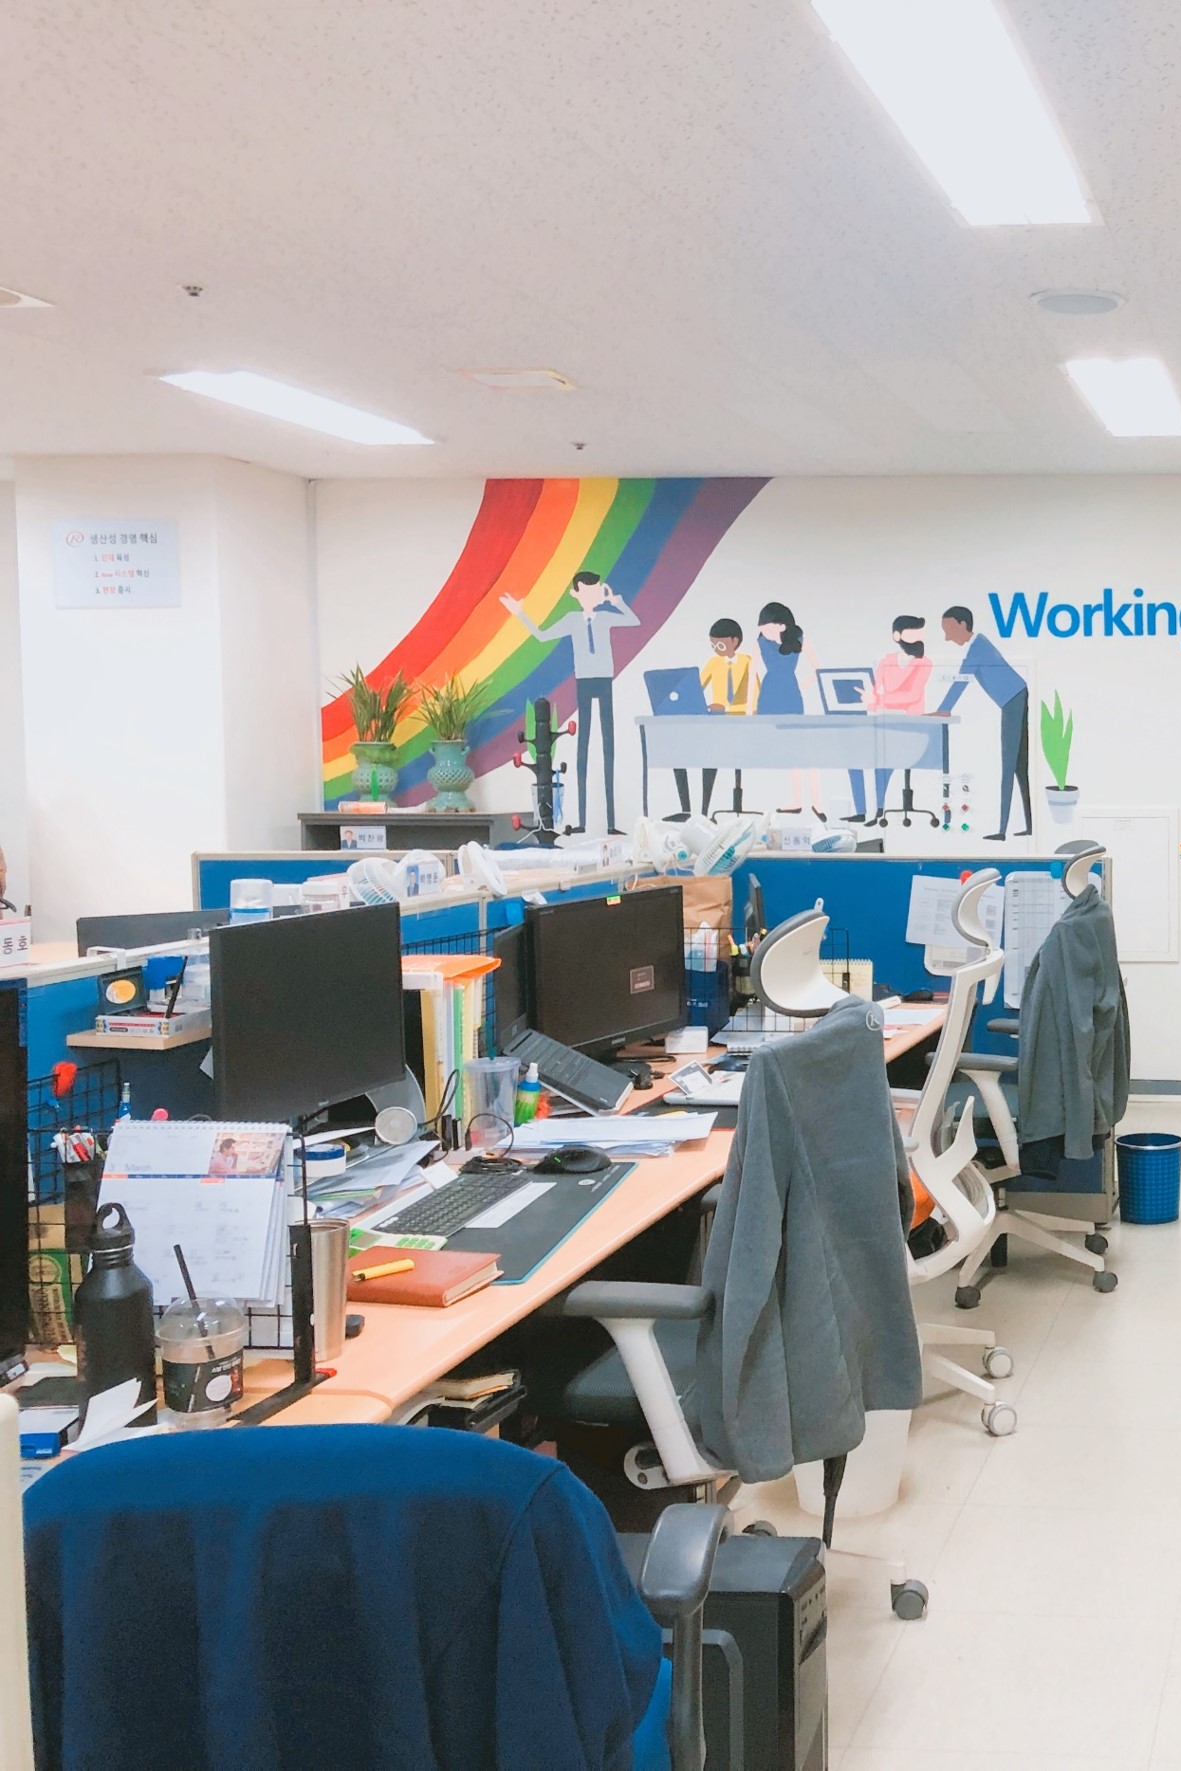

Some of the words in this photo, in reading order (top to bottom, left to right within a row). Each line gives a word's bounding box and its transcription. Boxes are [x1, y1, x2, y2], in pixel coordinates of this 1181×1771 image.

[90, 532, 117, 545] 생산성
[140, 532, 158, 545] 핵심
[115, 569, 135, 578] 시스템
[136, 569, 150, 578] 혁신
